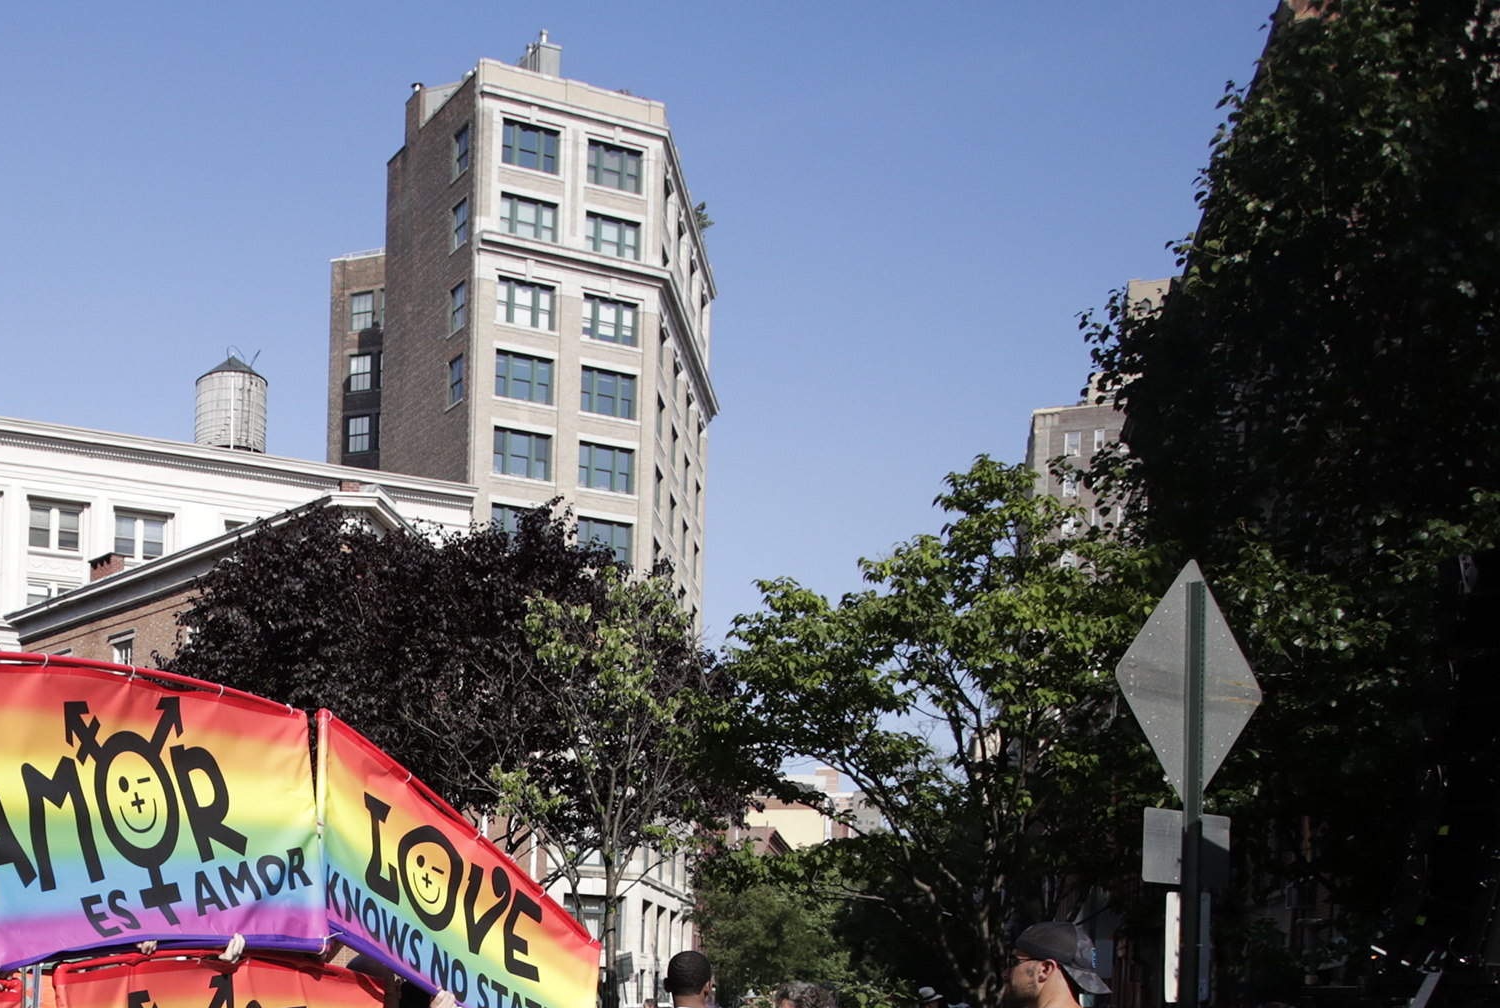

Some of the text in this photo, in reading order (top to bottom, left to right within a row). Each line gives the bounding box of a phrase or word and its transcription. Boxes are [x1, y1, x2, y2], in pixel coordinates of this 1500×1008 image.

[80, 846, 314, 938] ES AMOR
[326, 864, 424, 974] KNOWS
[430, 942, 468, 1003] NO
[364, 791, 542, 982] LOVE
